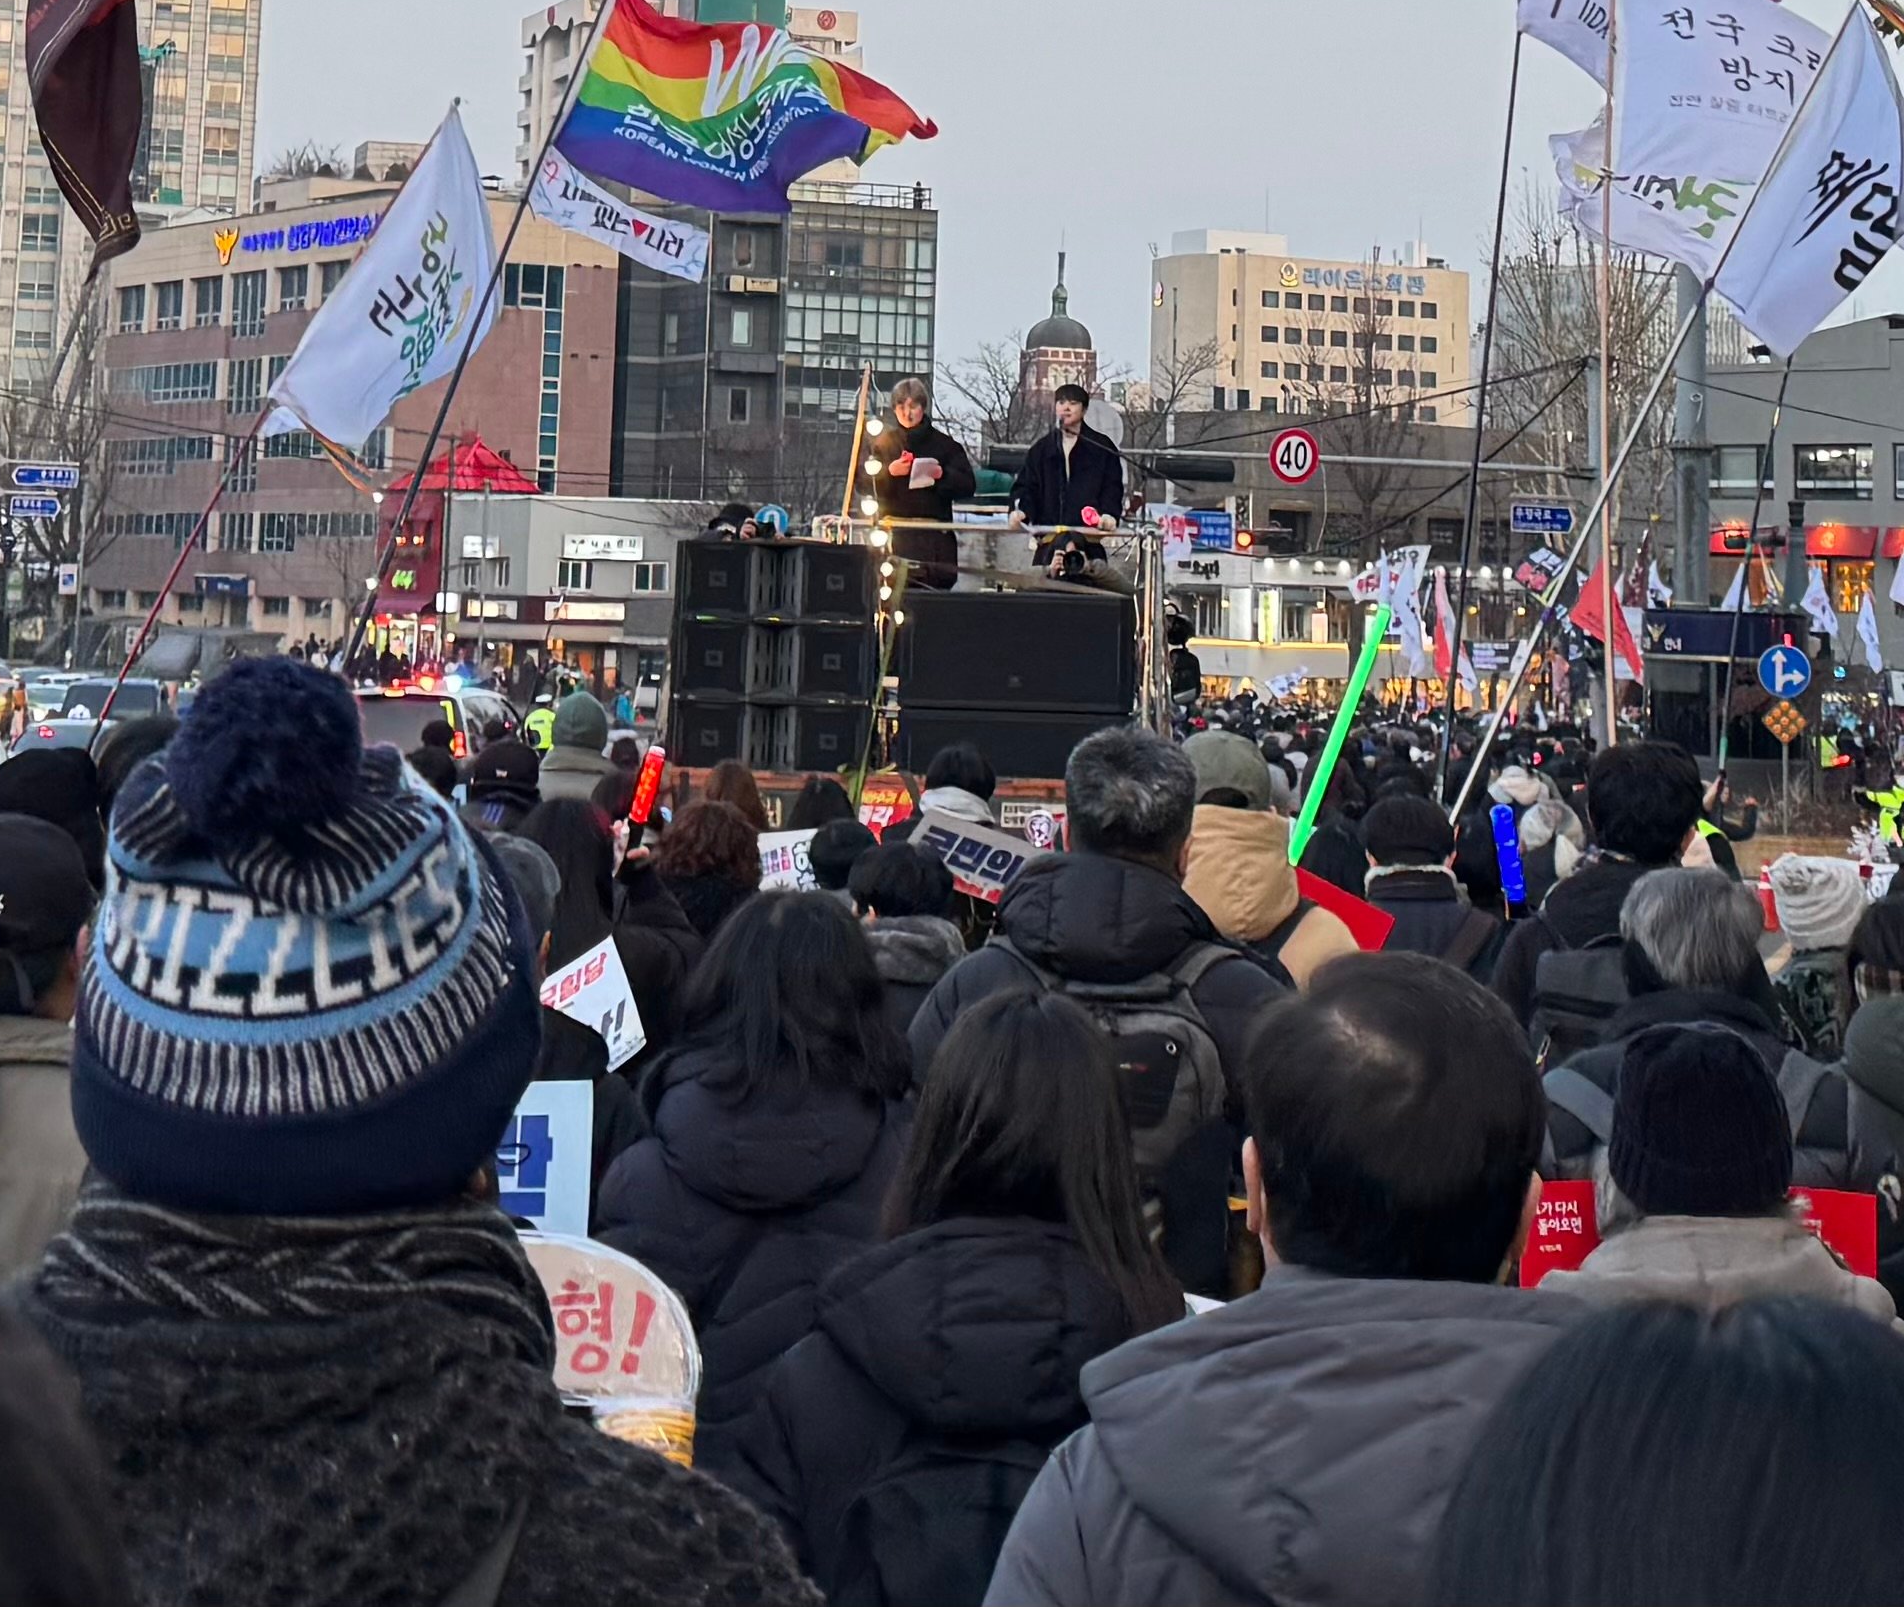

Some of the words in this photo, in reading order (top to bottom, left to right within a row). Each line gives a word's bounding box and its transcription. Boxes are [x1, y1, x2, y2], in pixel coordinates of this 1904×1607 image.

[1659, 6, 1746, 46] 전국
[1720, 56, 1794, 106] 방지
[612, 126, 679, 161] KOREAN
[1279, 442, 1307, 471] 40
[104, 843, 464, 1016] RIZZLIES
[1554, 1200, 1578, 1216] 다시
